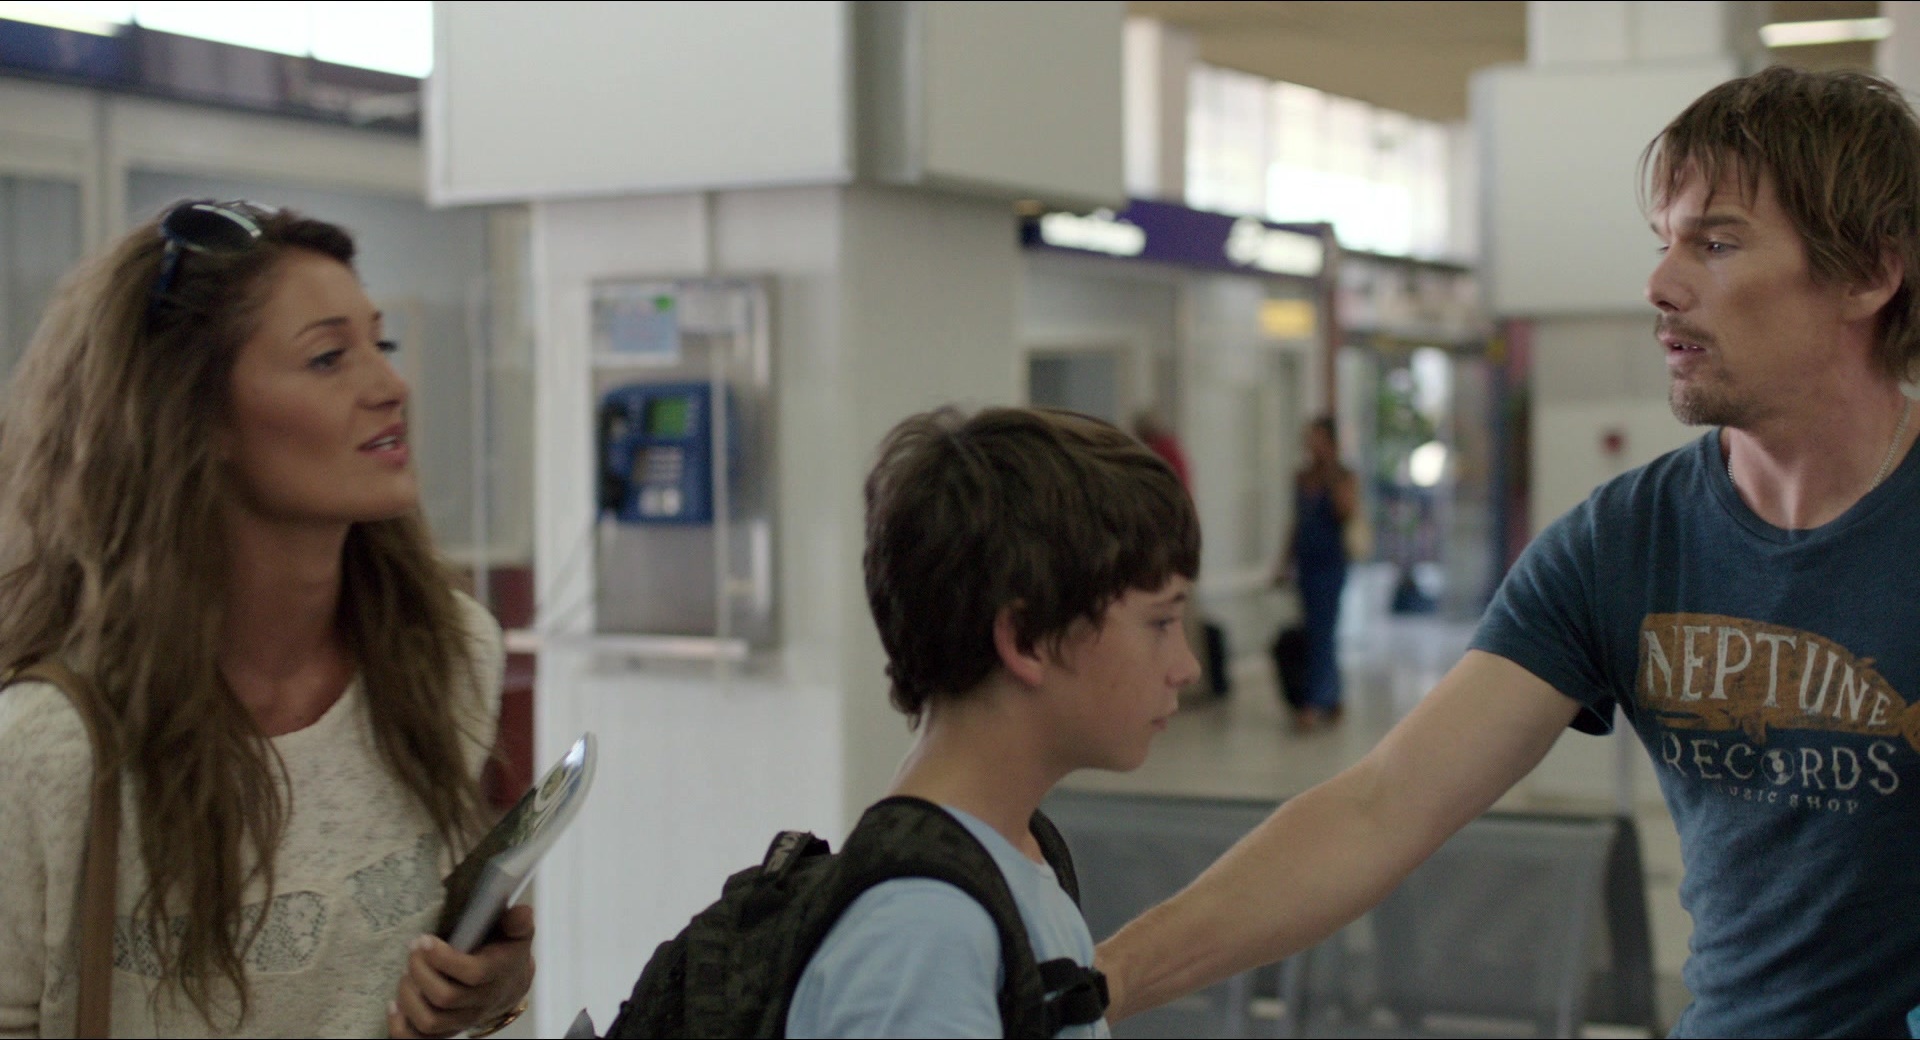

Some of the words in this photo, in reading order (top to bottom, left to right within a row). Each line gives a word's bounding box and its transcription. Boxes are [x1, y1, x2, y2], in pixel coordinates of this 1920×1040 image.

[1643, 625, 1892, 727] NEPTUNE
[1661, 731, 1899, 795] RECORDS
[1788, 793, 1859, 814] SHOP
